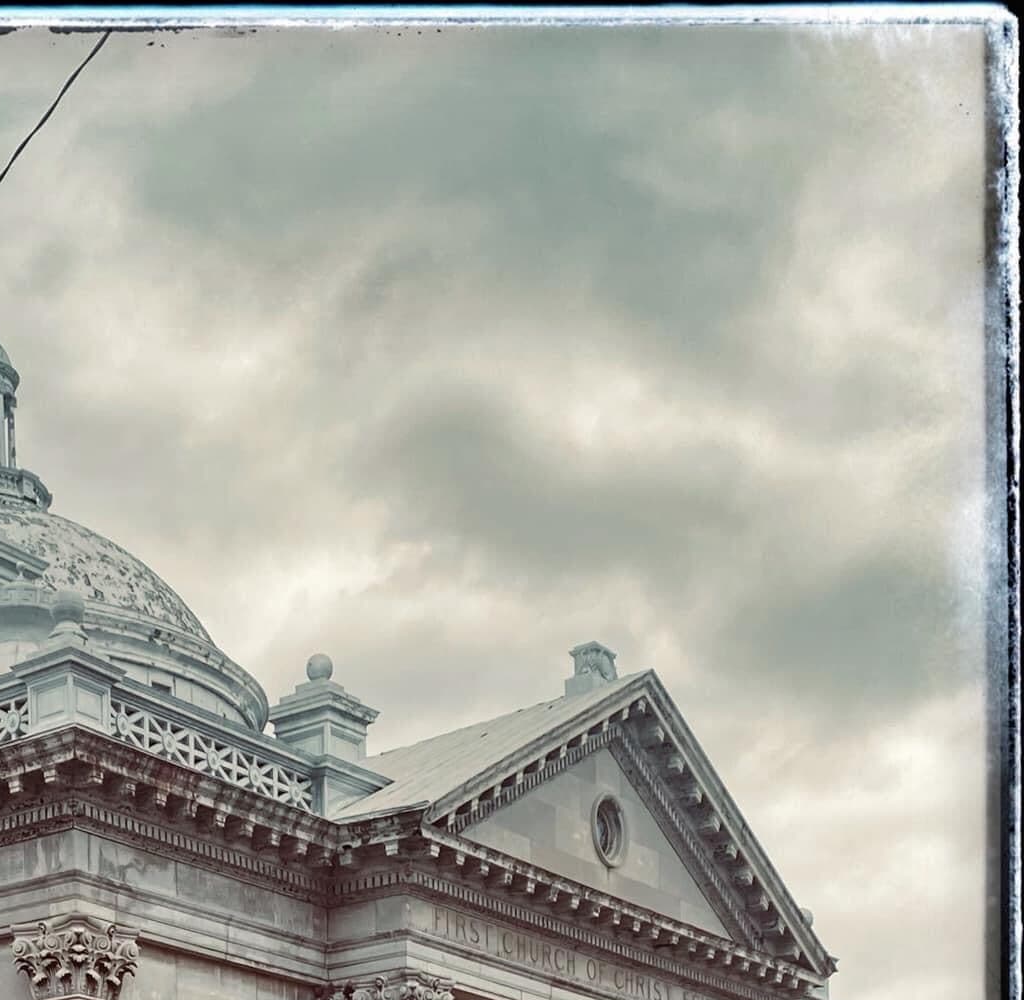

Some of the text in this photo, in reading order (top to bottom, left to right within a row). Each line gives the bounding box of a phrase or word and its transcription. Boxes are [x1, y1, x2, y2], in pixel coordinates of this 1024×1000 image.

[434, 907, 493, 949] FIRST
[502, 932, 576, 974] CHURCH
[586, 958, 607, 984] OF
